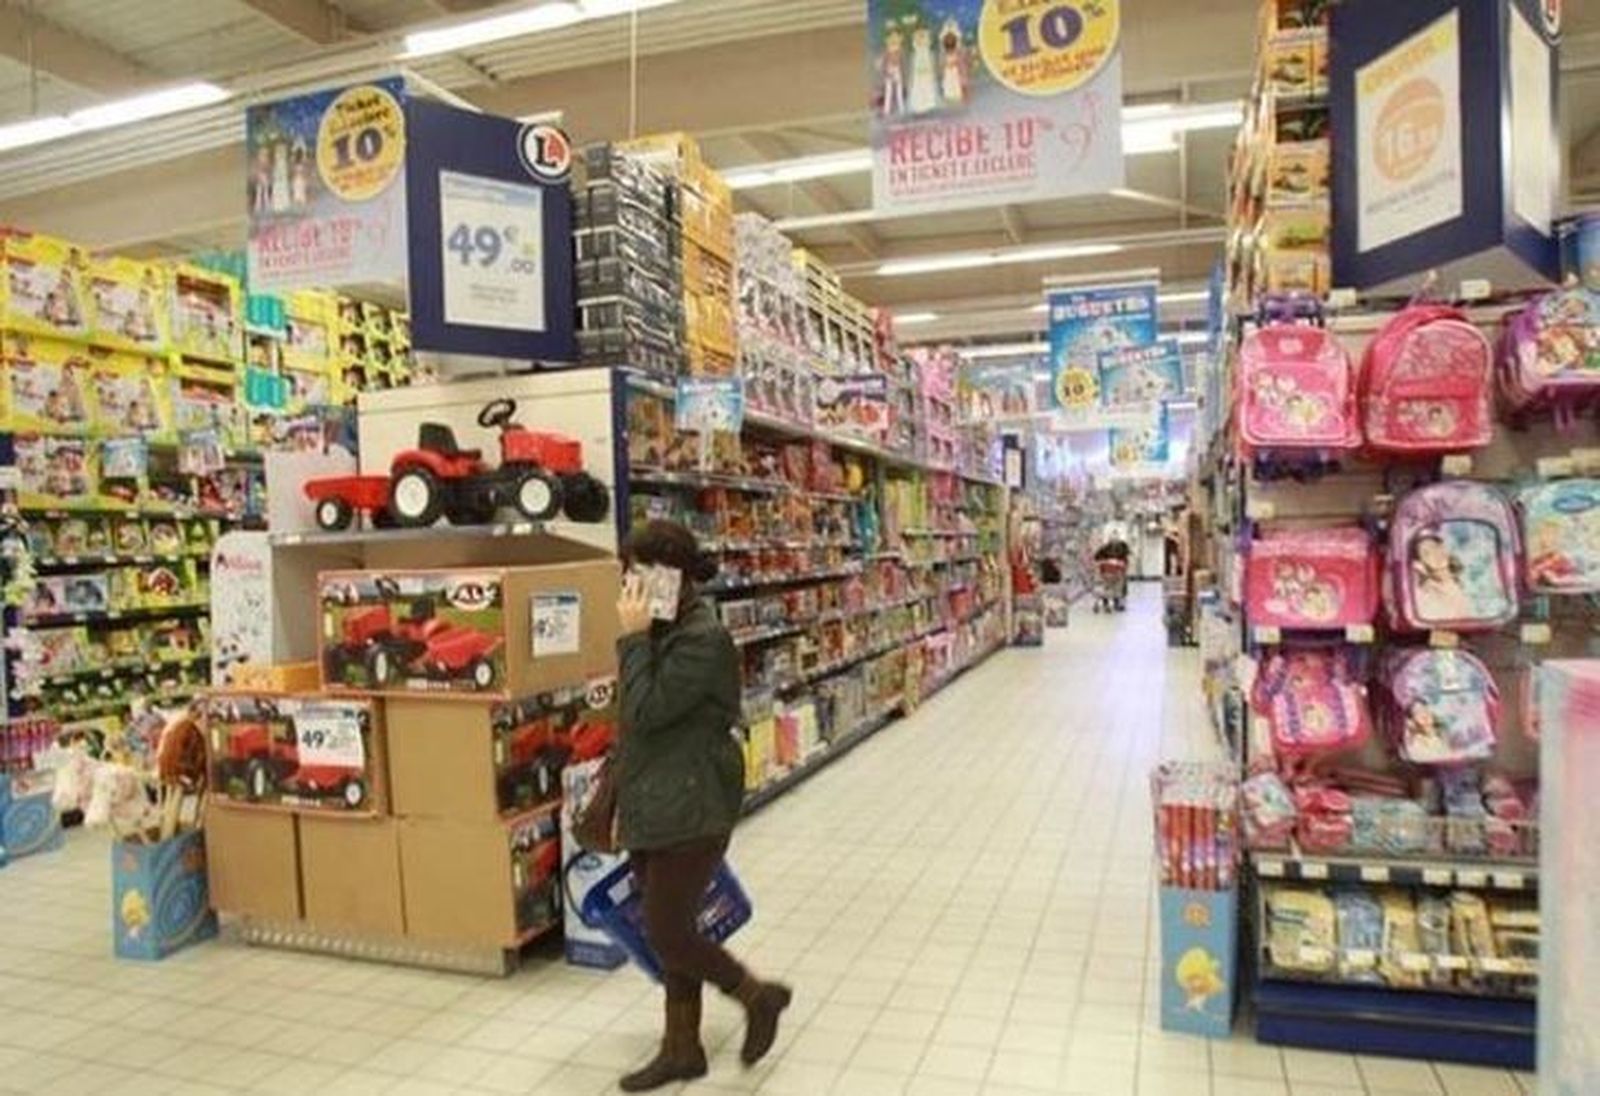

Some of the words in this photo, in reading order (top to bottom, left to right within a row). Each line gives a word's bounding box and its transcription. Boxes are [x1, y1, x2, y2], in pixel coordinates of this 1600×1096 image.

[887, 124, 990, 165] RECIBE
[448, 224, 503, 268] 49
[302, 729, 325, 749] 49
